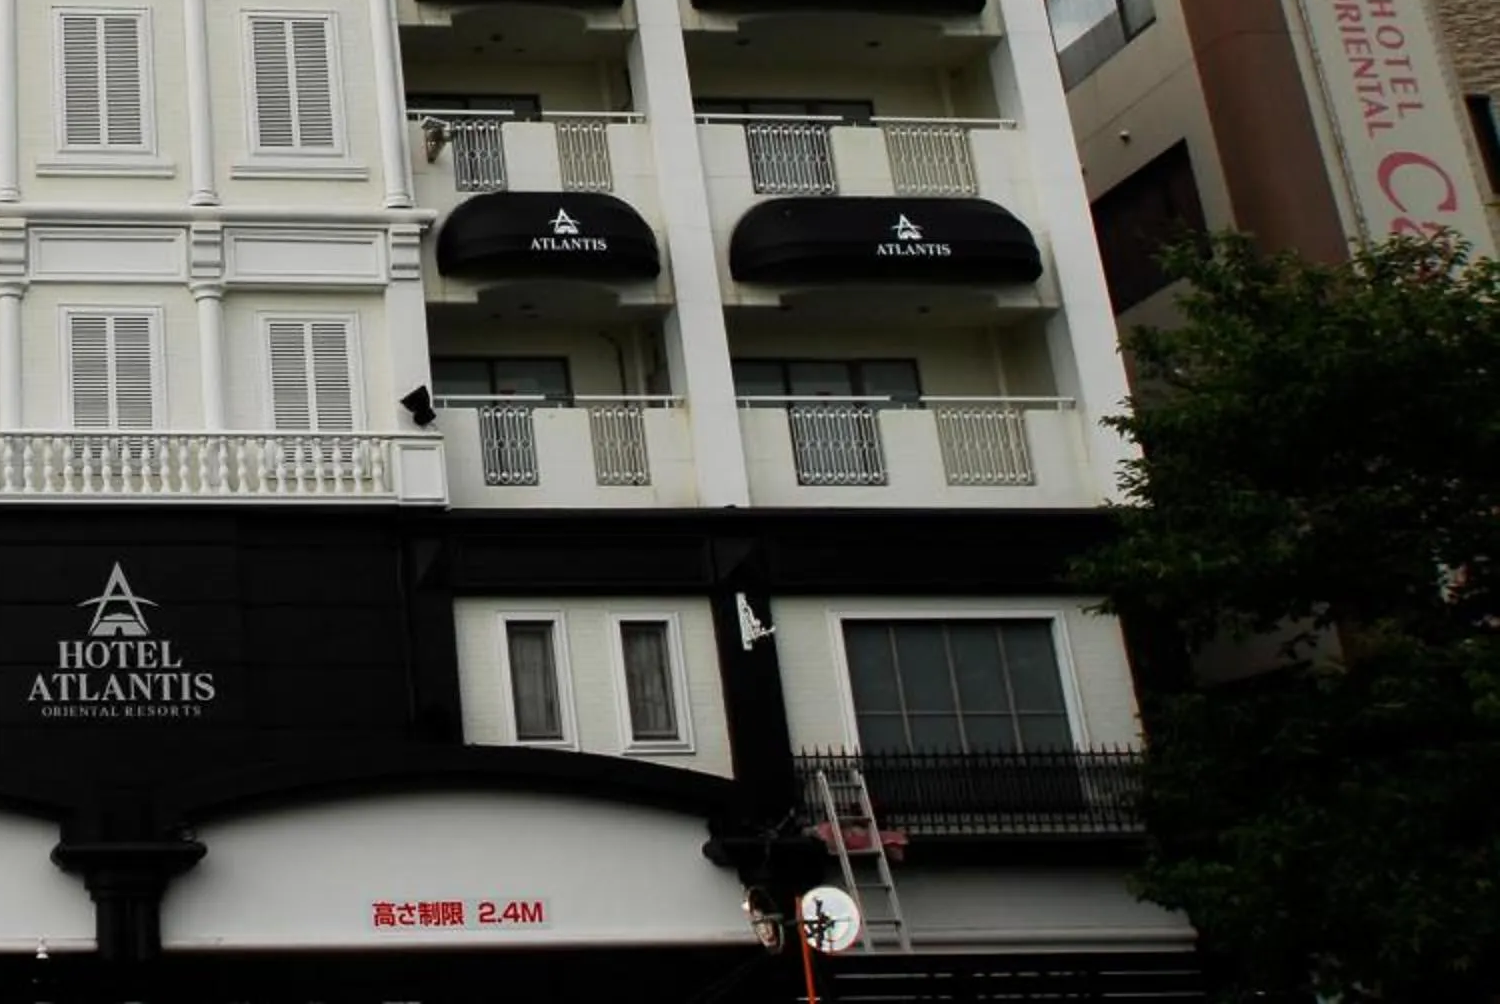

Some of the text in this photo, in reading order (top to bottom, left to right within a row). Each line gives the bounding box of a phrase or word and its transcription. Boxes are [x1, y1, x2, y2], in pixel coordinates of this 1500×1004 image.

[531, 237, 608, 251] ATLANTIS
[876, 243, 951, 256] ATLANTIS
[58, 640, 183, 669] HOTEL
[28, 672, 216, 701] ATLANTIS
[41, 704, 202, 718] ORIENTAL RESORTS
[372, 902, 543, 927] 高さ制限 2.4M
